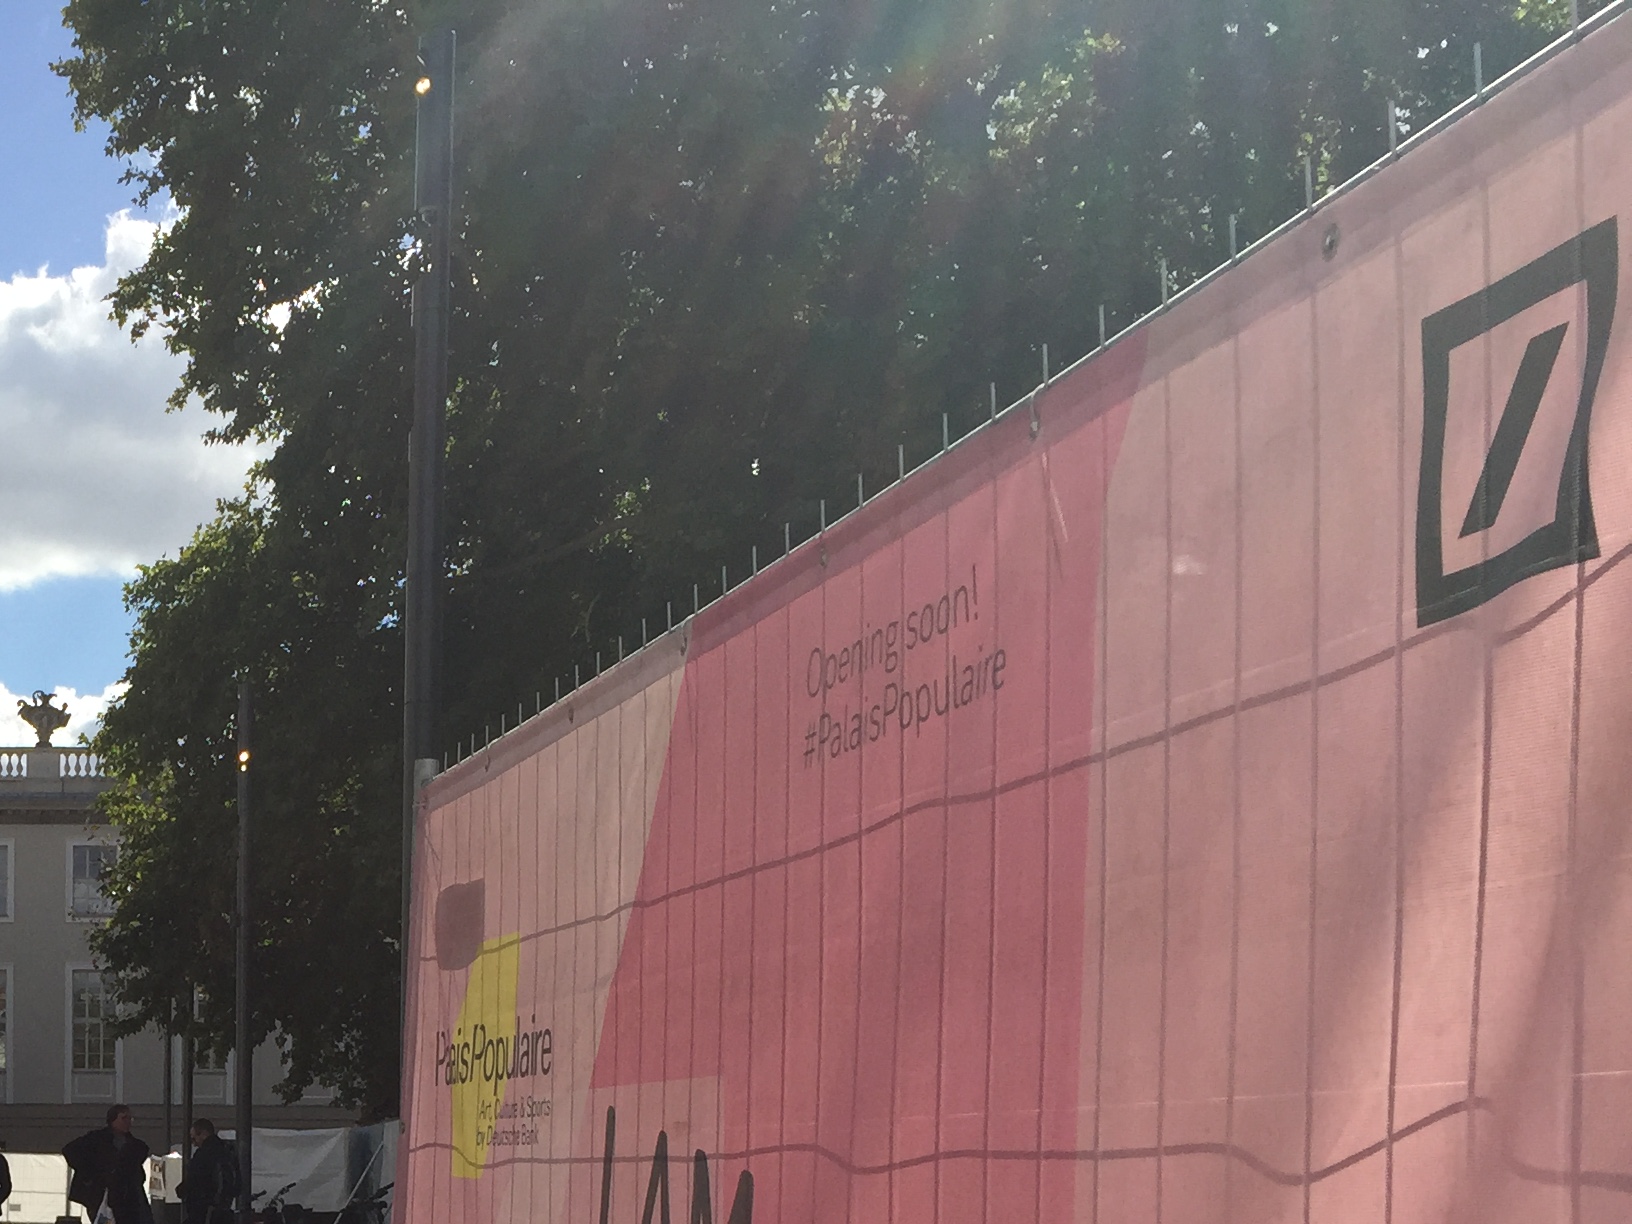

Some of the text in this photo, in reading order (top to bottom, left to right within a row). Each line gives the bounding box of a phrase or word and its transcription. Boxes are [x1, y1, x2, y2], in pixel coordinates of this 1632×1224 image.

[806, 563, 979, 706] Opening soon!
[802, 643, 1007, 770] #PalaisPopulaire
